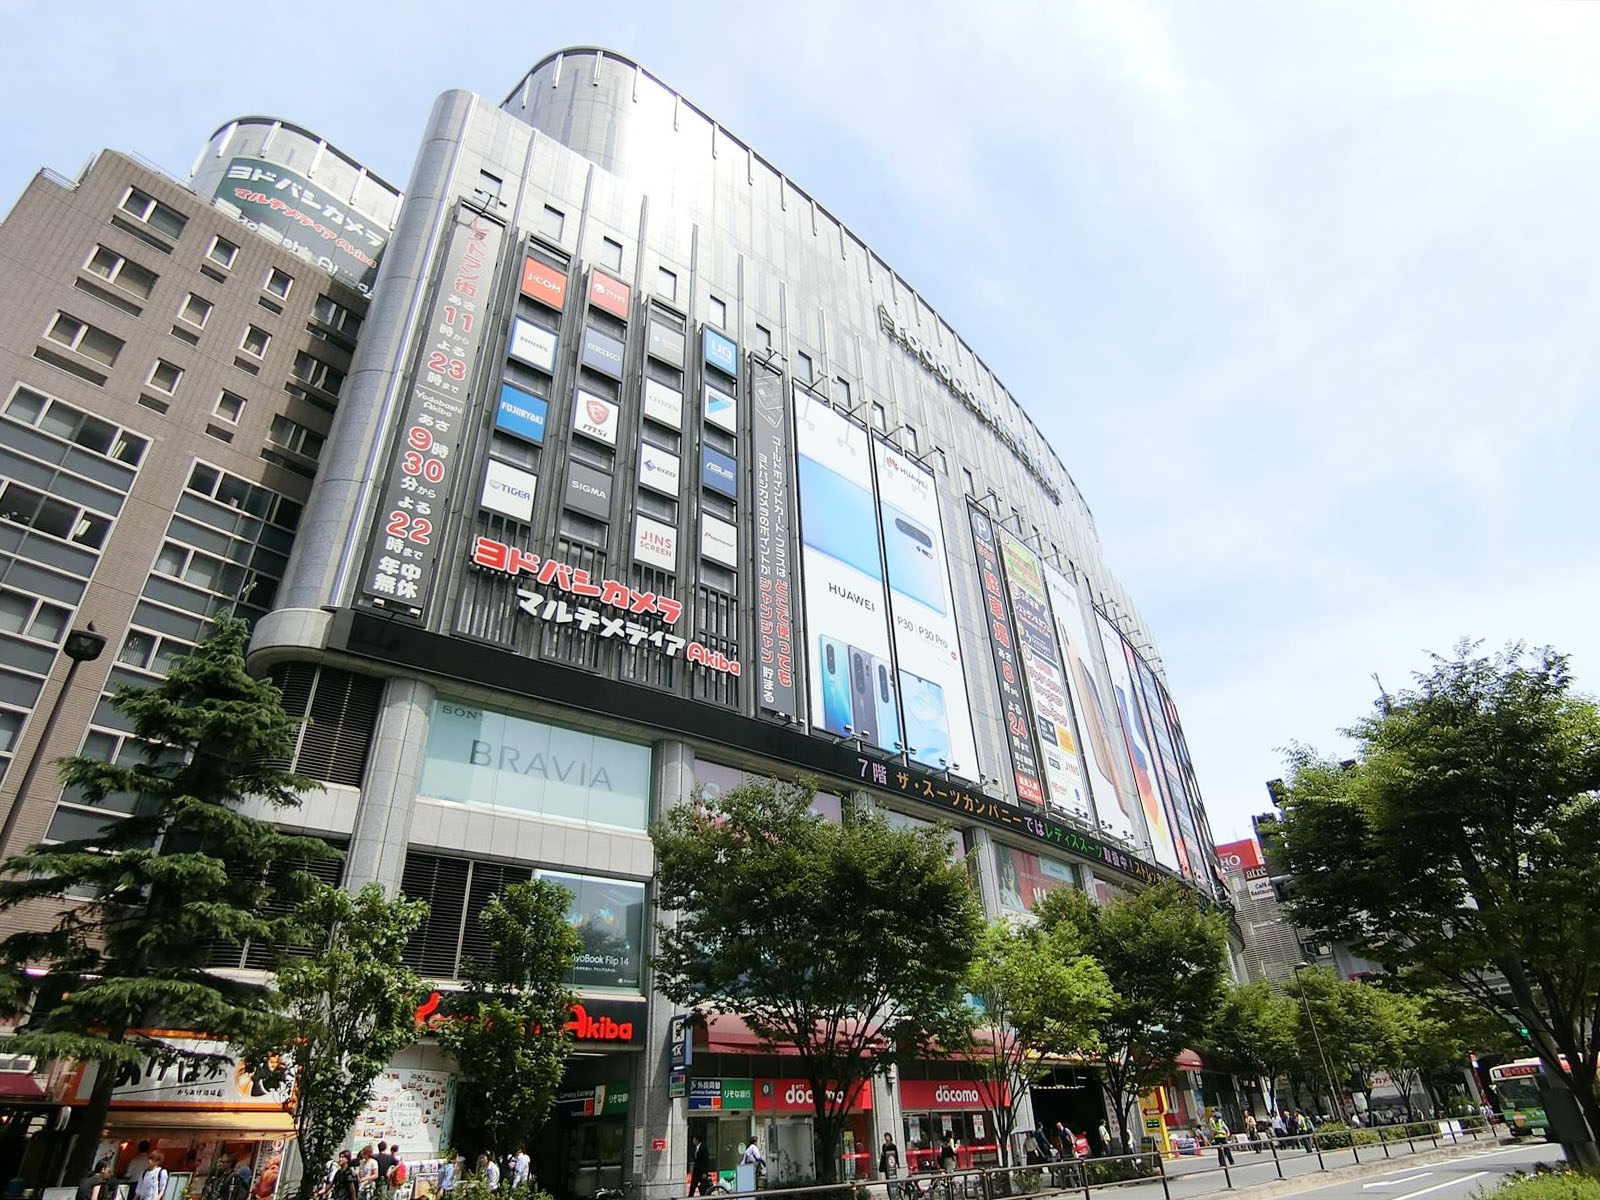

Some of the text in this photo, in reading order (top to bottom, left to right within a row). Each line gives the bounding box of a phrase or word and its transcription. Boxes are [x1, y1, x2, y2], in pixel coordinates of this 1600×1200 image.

[228, 165, 385, 247] ヨドバシカメラ
[449, 294, 476, 312] あさ
[444, 305, 473, 333] 11
[439, 325, 469, 345] 時から
[437, 340, 466, 358] よる
[587, 342, 621, 362] SEIKO
[427, 351, 467, 381] 23
[426, 372, 460, 394] 時まで
[416, 389, 463, 414] Yodobashi
[423, 401, 453, 418] Akiba
[418, 412, 451, 433] あさ
[582, 423, 607, 438] msi
[401, 450, 445, 484] 30
[900, 466, 929, 491] HUAWEI
[400, 475, 437, 499] 分から
[502, 484, 531, 501] TIGER
[571, 480, 607, 500] SIGMA
[398, 495, 432, 516] よる
[386, 510, 433, 546] 22
[640, 530, 672, 549] JINS
[385, 535, 424, 560] 時まで
[640, 541, 672, 557] SCREEN
[378, 555, 422, 581] 年中
[473, 536, 682, 624] ヨドバシカメラ
[373, 573, 418, 599] 無休
[828, 582, 876, 613] HUAWEI
[517, 588, 741, 677] マルチメディア Akiba
[896, 615, 949, 649] P30 P30 Pro
[1008, 711, 1028, 741] 24
[469, 739, 613, 791] BRAVIA
[857, 758, 887, 785] 7階
[605, 955, 619, 967] Flip
[620, 956, 629, 966] 14
[566, 1003, 632, 1040] Akiba
[724, 1089, 751, 1099] りそな銀行
[935, 1085, 979, 1102] docomo
